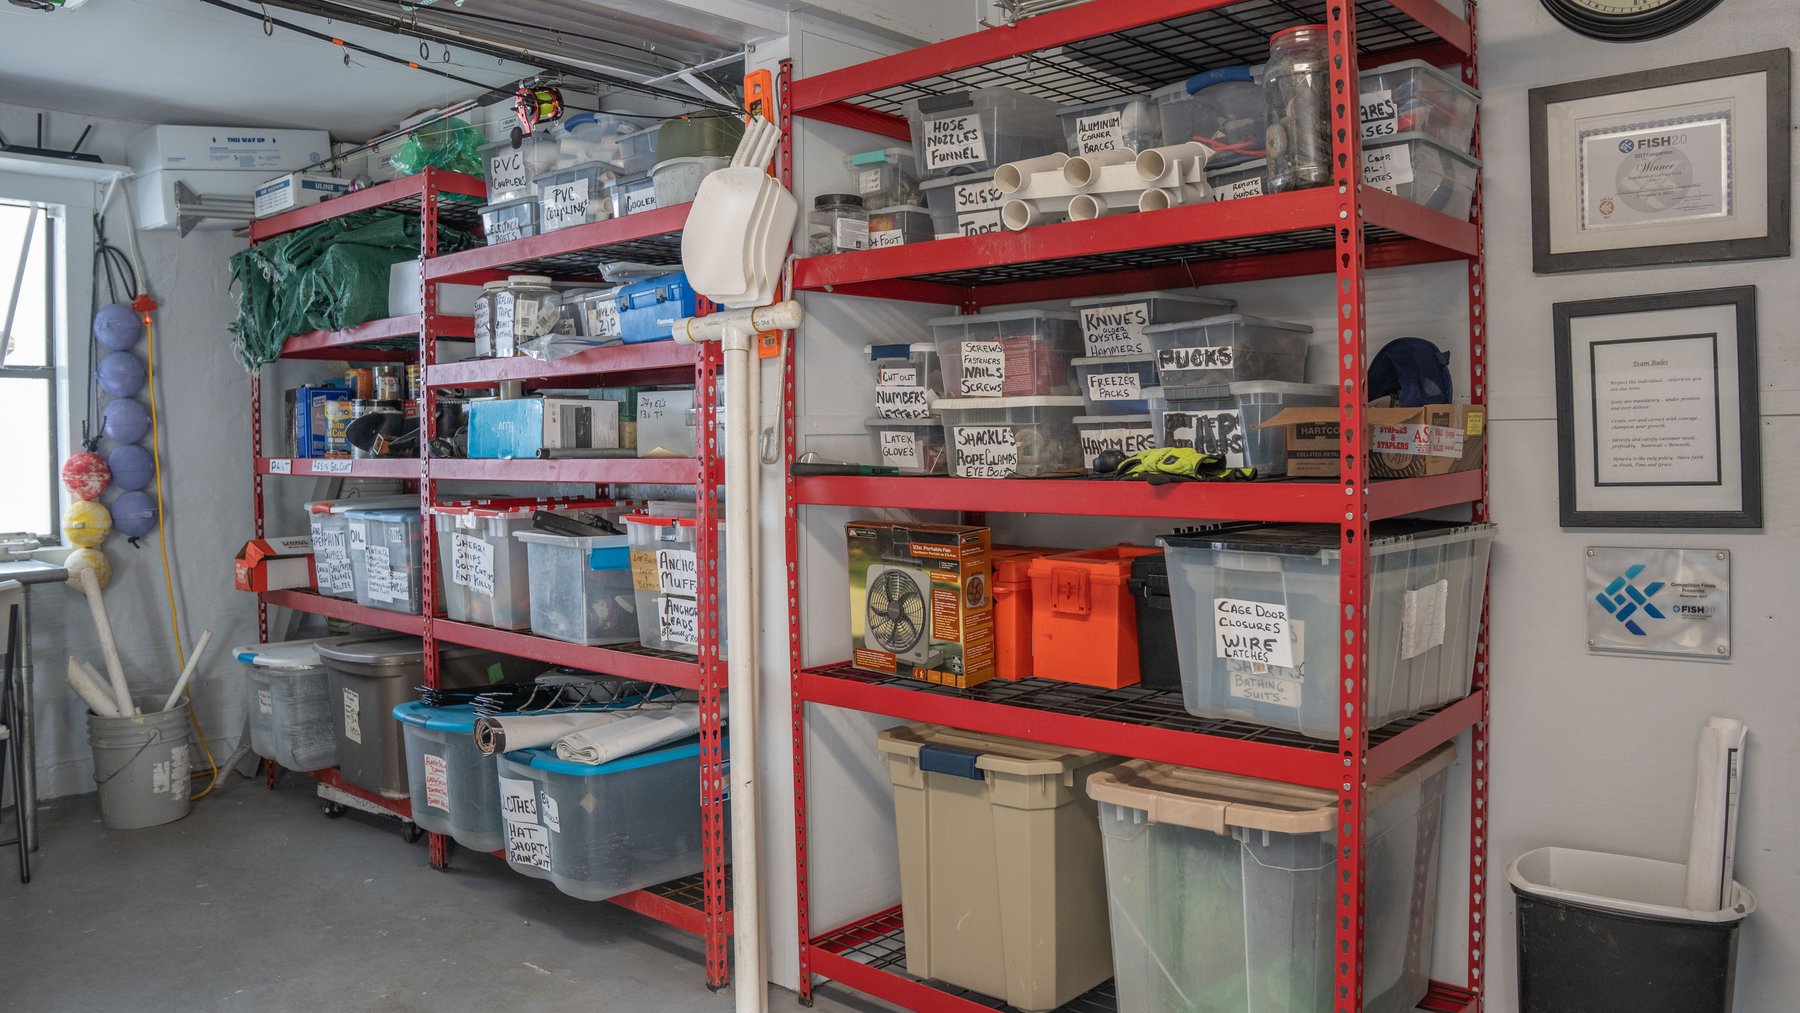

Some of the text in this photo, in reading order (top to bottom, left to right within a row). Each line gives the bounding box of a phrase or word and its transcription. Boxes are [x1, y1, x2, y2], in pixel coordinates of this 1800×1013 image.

[1360, 99, 1395, 120] ARES
[933, 118, 968, 131] HOSE
[1078, 116, 1121, 134] ALUMINUM
[927, 129, 978, 148] NOZZLES
[1081, 131, 1113, 142] CORNER
[1637, 136, 1672, 149] FISH
[1084, 140, 1115, 154] BRACES
[493, 153, 520, 174] PVC
[931, 147, 980, 166] FUNNEL
[1636, 161, 1675, 173] Winner
[315, 183, 334, 191] ULINE
[493, 176, 527, 190] COUPLERS
[1232, 180, 1259, 189] REMOTE
[552, 186, 575, 203] PVC
[957, 188, 1004, 206] SCISSO
[1233, 188, 1260, 200] GUIDES
[626, 196, 656, 212] COOLER
[599, 318, 616, 333] ZIP
[1085, 309, 1147, 332] KNIVES
[1088, 331, 1131, 344] OYSTER
[966, 343, 1003, 353] SCREWS
[1090, 343, 1143, 357] HAMMERS
[963, 354, 1001, 366] FASTENERS
[1159, 346, 1233, 369] PUCKS
[882, 372, 915, 382] CUT OUT
[964, 365, 1004, 380] NAILS
[961, 379, 1002, 393] SCREWS
[1089, 375, 1136, 389] FREEZER
[876, 391, 927, 405] NUMBERS
[1099, 388, 1130, 398] PACKS
[957, 428, 1016, 446] SHACKLES
[1301, 426, 1341, 435] HARTCO
[884, 434, 913, 444] LATEX
[1082, 434, 1156, 454] HAMMERS
[883, 447, 914, 457] GLOVES
[957, 450, 1017, 467] ROPE CLAMPS
[965, 467, 983, 477] EYE
[323, 532, 344, 546] PAINT
[351, 529, 364, 543] OIL
[457, 548, 481, 565] SNIPS
[660, 551, 697, 574] ANCHO
[455, 559, 475, 571] BOLT
[455, 570, 472, 583] ANT
[661, 572, 697, 593] MUFF
[1218, 601, 1287, 622] CAGE DOOR
[1682, 605, 1705, 614] FISH
[1219, 618, 1281, 634] CLOSURES
[1222, 634, 1278, 653] WIRE
[1225, 648, 1269, 663] LATCHES
[1235, 674, 1284, 693] BATHING
[1243, 688, 1280, 702] SUITS
[502, 796, 537, 815] LOTHES
[509, 823, 538, 839] HAT
[510, 838, 550, 858] SHORTS
[511, 851, 550, 869] RAIN SUIT
